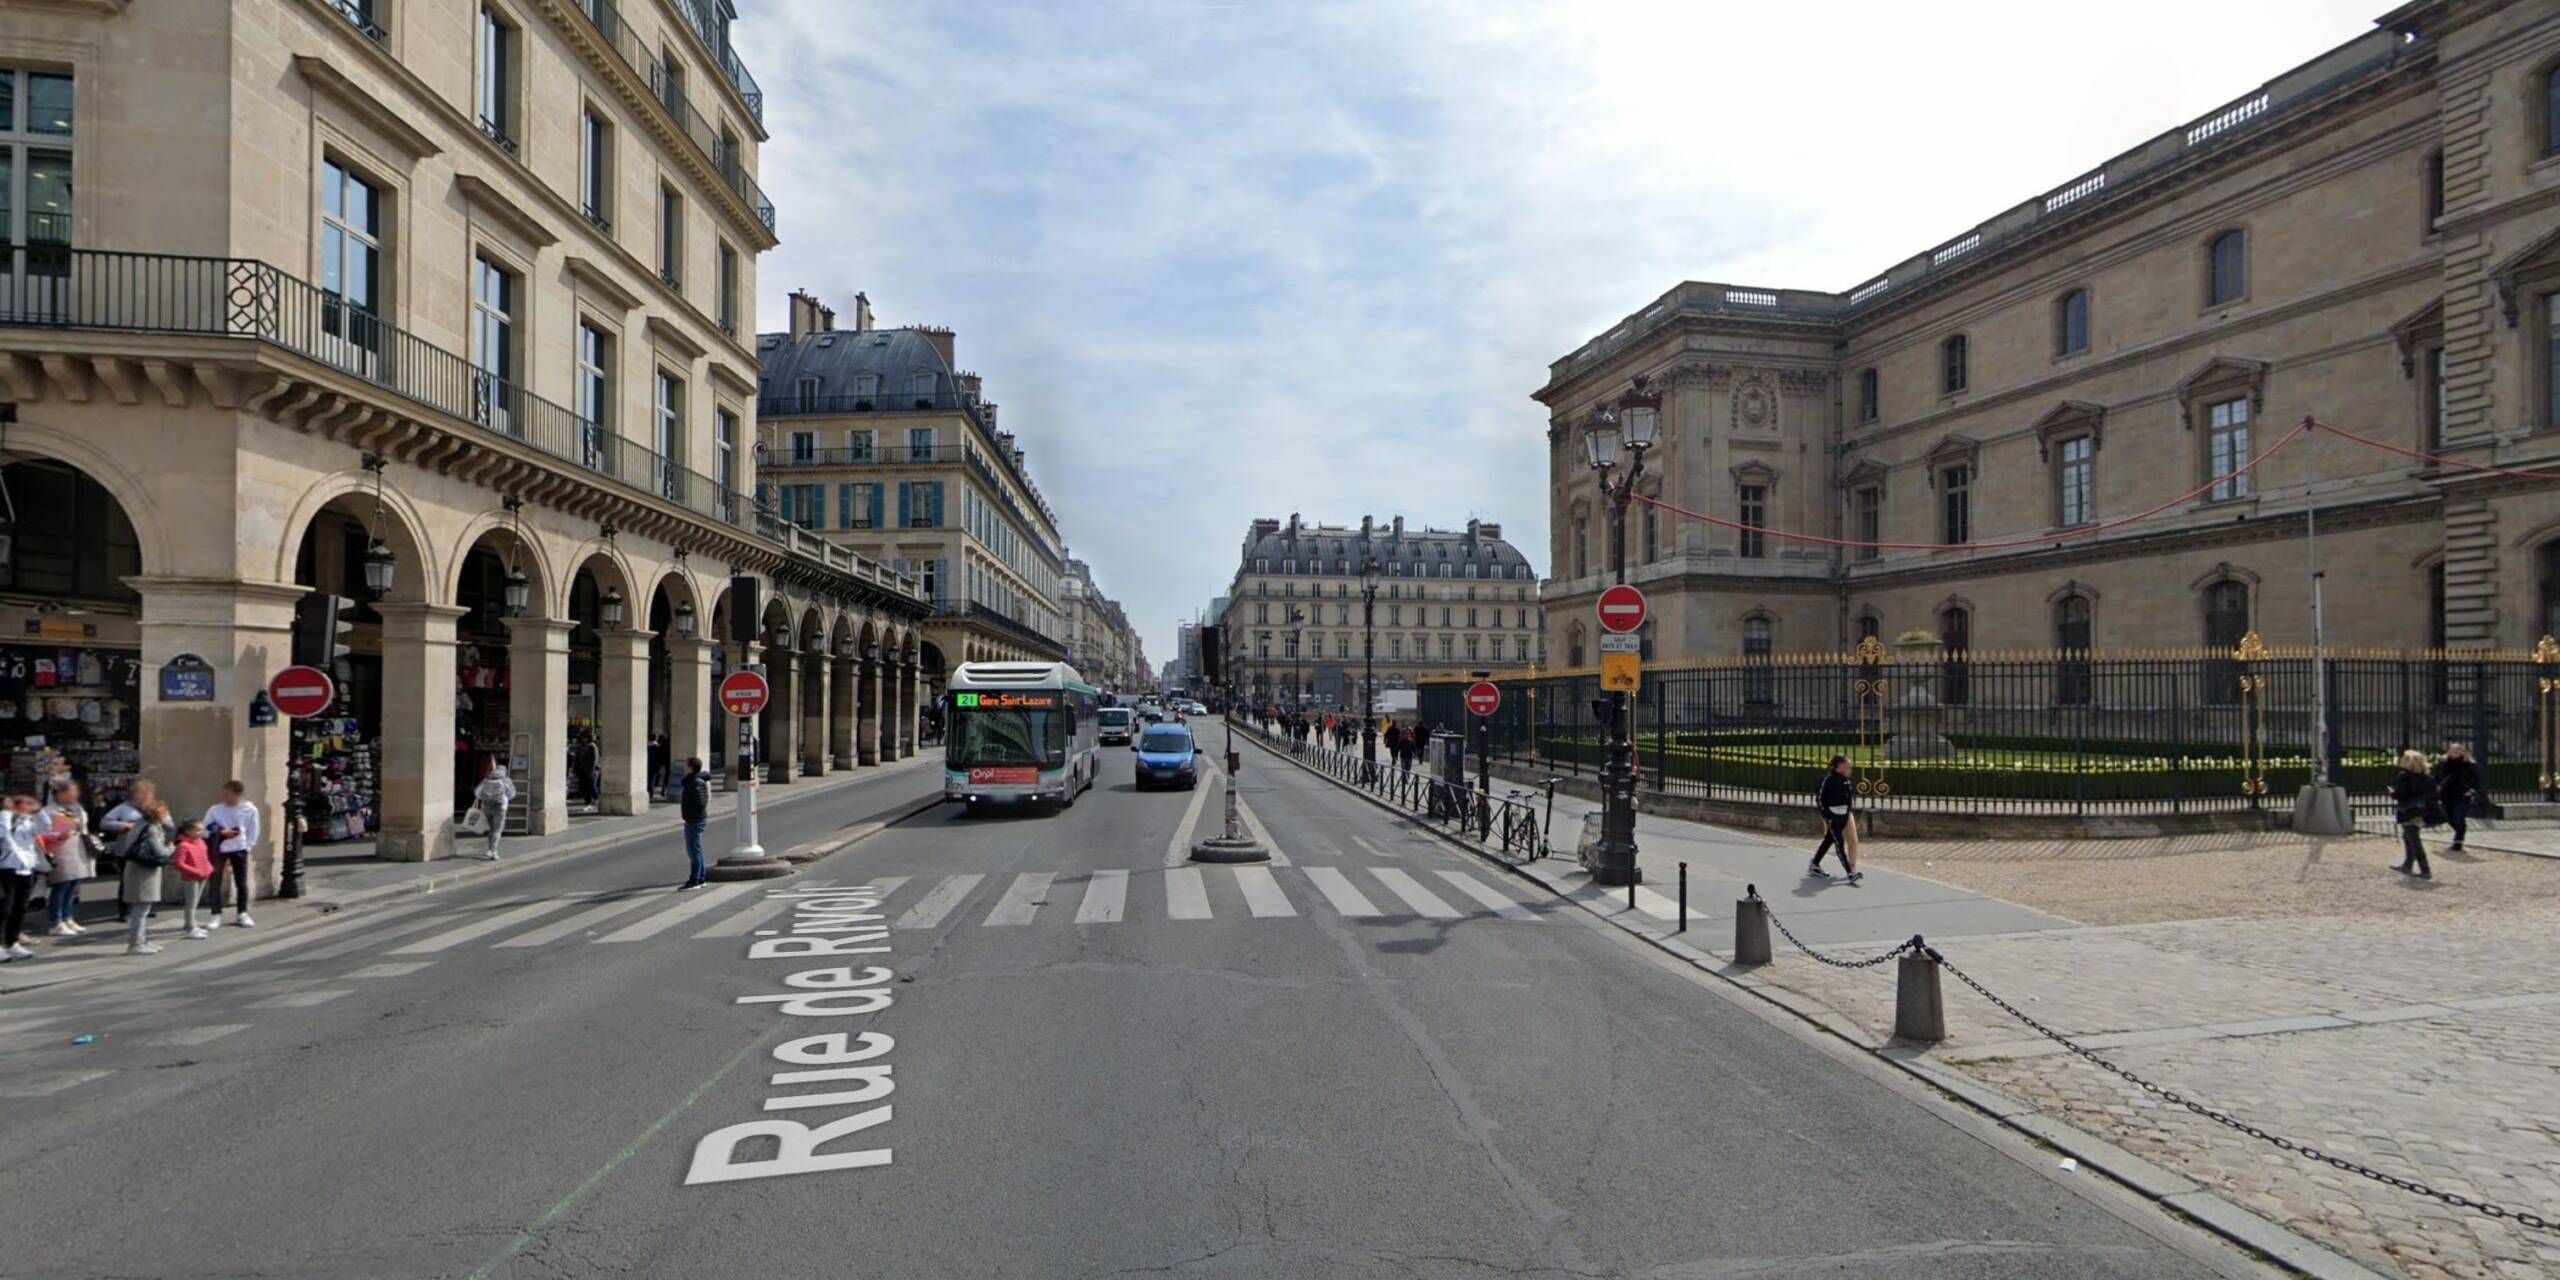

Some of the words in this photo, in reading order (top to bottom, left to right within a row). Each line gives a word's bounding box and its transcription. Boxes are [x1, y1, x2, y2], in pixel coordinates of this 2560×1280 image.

[128, 664, 137, 680] 7
[962, 695, 974, 705] 21
[979, 694, 999, 706] Gare
